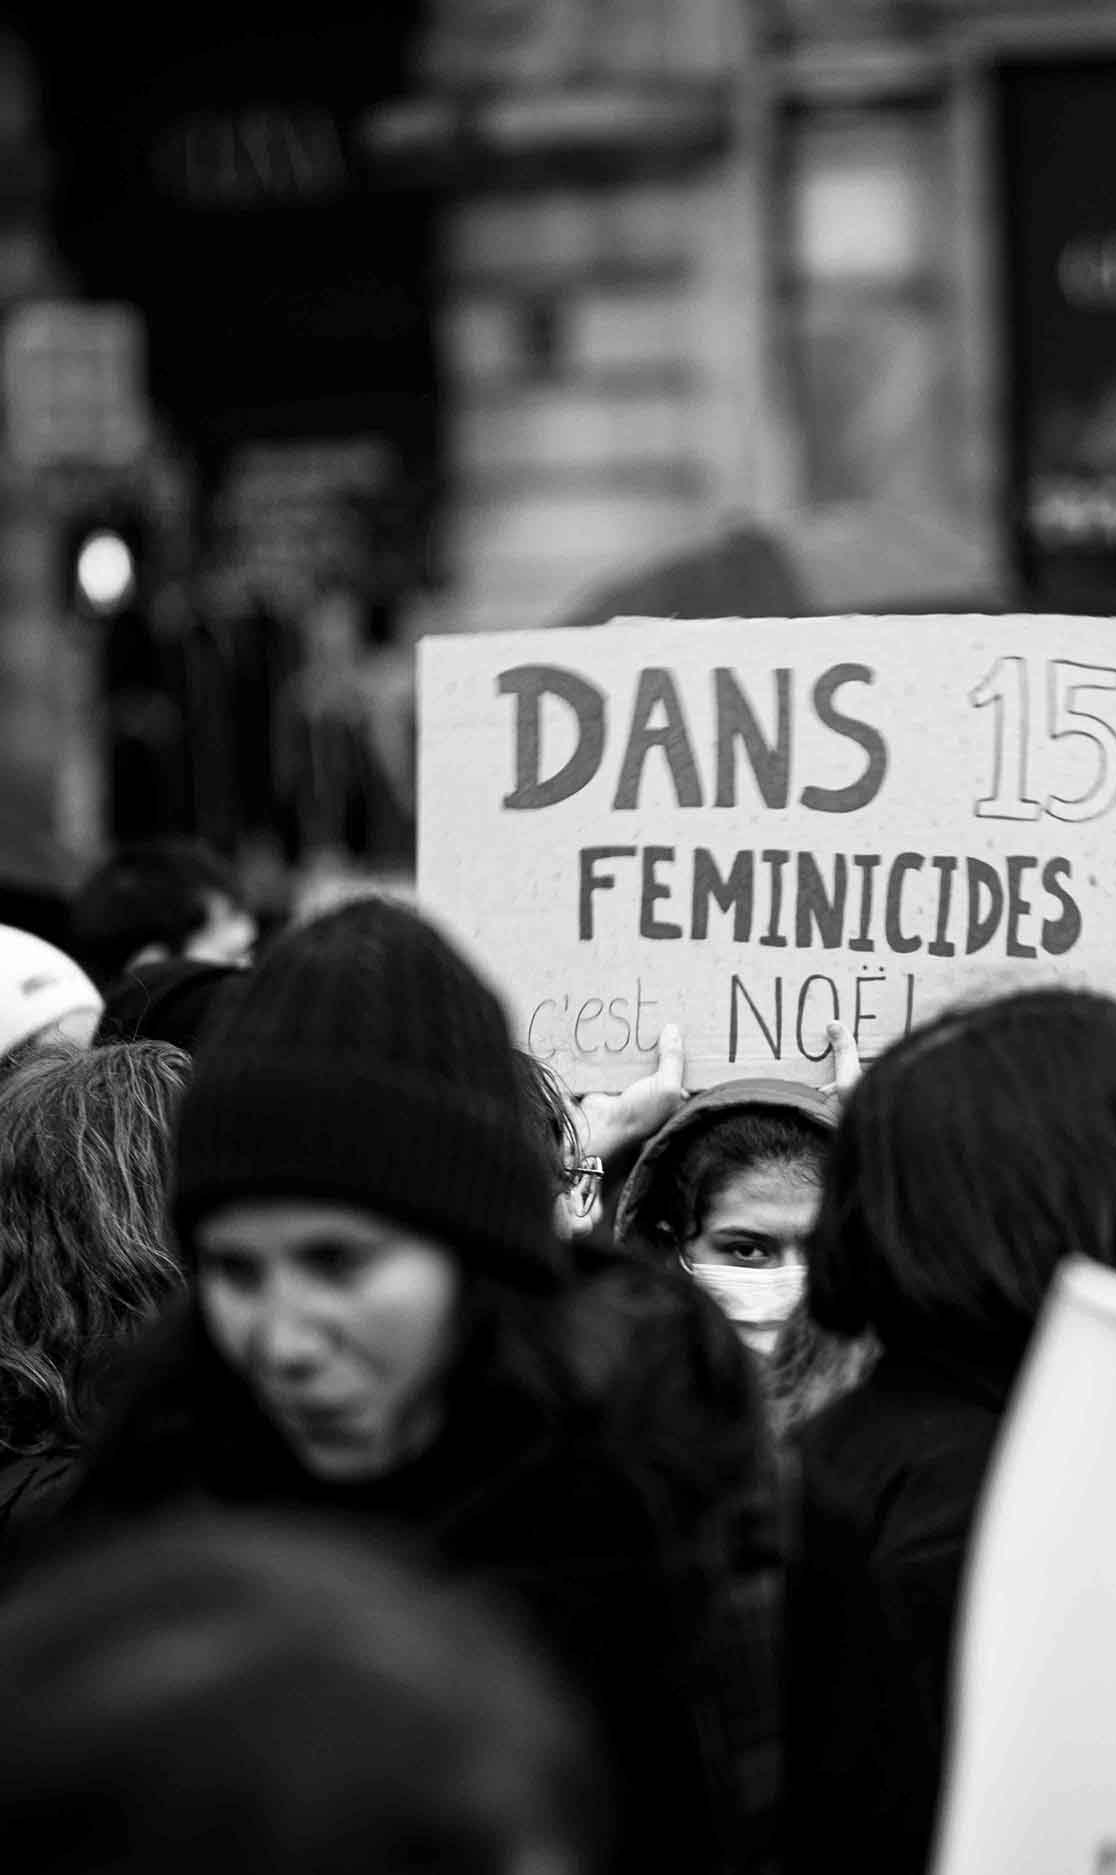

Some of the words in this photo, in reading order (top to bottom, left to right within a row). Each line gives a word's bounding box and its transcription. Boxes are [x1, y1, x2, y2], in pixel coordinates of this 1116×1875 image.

[496, 662, 889, 813] DANS
[578, 845, 1083, 959] FEMINICIDES
[526, 974, 659, 1061] c'est
